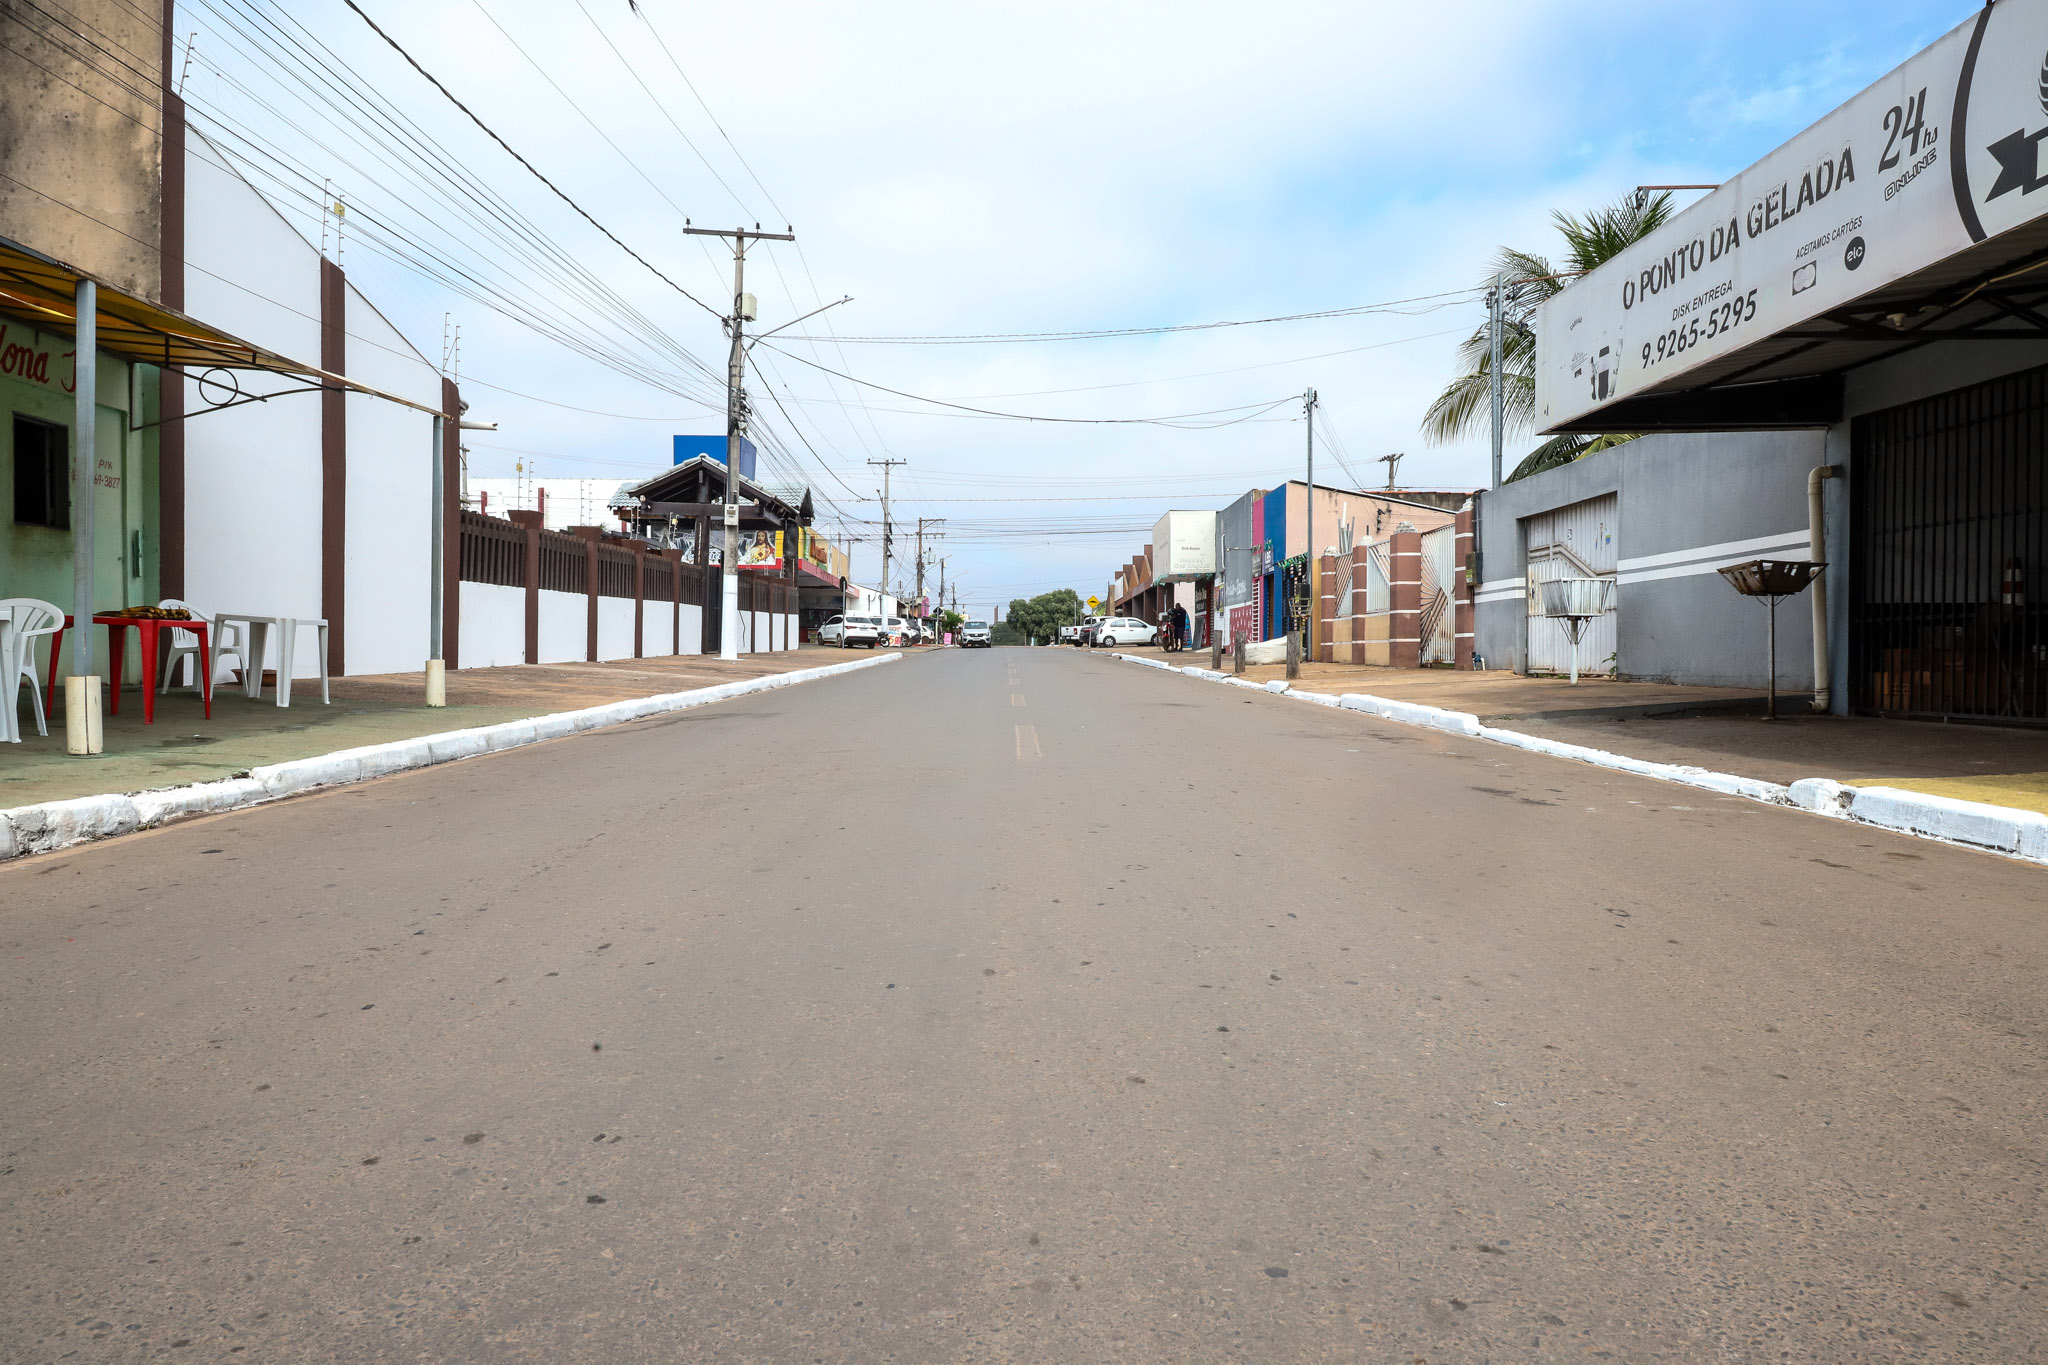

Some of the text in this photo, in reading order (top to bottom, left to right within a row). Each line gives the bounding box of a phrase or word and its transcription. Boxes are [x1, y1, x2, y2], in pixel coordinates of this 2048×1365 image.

[1884, 147, 1937, 202] ONLINE
[1622, 144, 1856, 310] O PONTO DA GELADA
[1795, 215, 1863, 260] ACEITAMOS CARTÕES
[1671, 279, 1733, 322] DISK ENTREGA
[1641, 287, 1758, 370] 9.9265-5295
